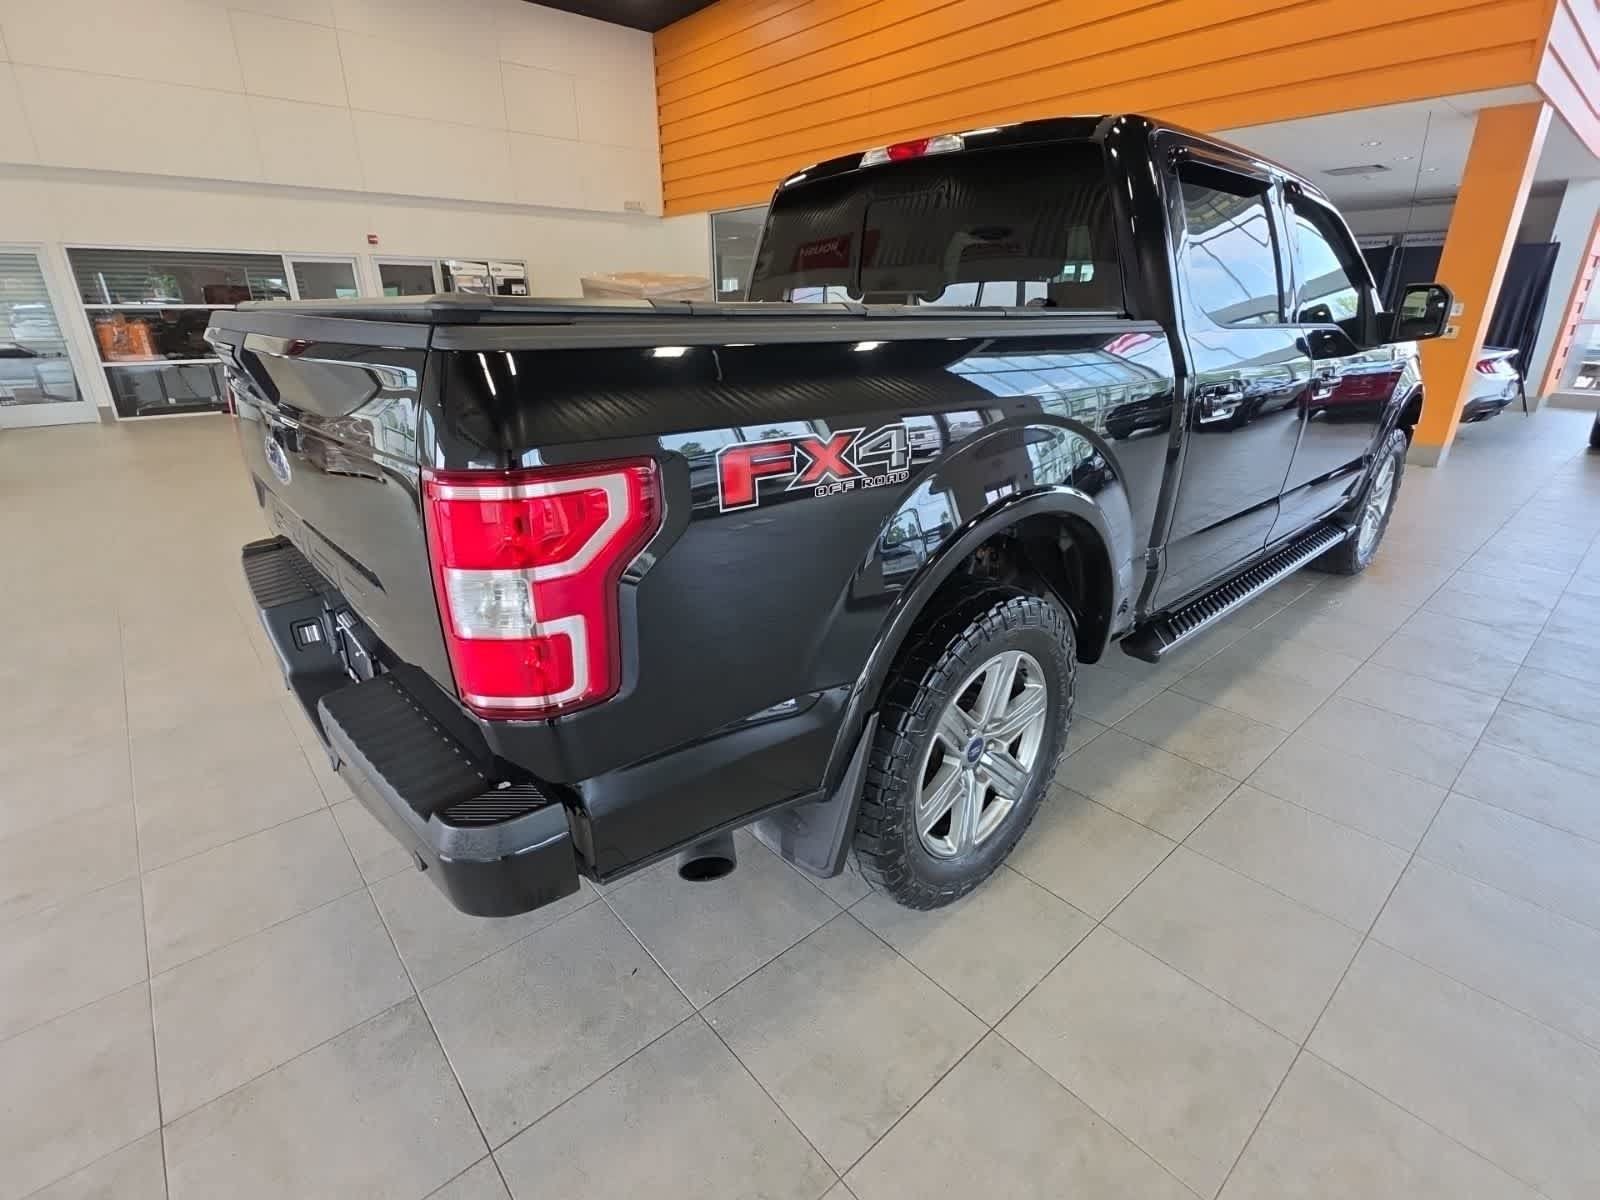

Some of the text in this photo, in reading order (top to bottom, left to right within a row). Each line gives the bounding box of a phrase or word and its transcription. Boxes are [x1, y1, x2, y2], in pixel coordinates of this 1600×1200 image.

[716, 423, 911, 512] FX4
[814, 470, 910, 498] OFF ROAD
